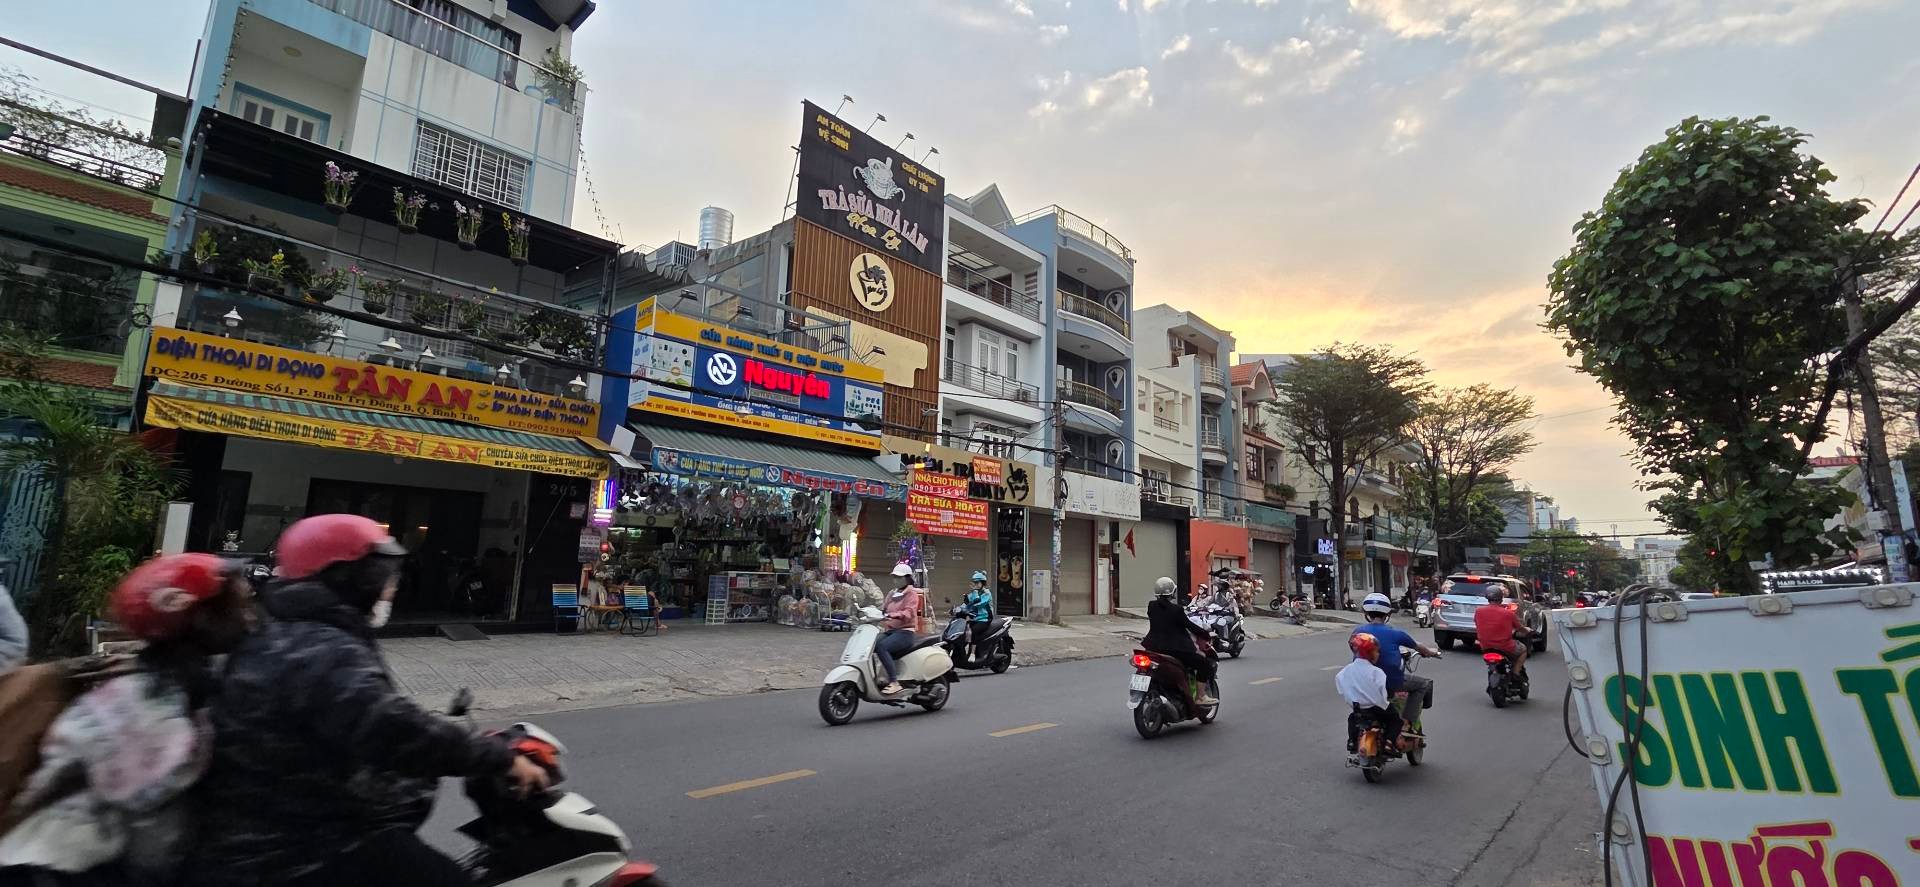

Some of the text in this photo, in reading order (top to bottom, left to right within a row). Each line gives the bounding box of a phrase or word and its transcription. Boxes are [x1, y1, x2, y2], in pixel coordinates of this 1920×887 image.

[816, 114, 851, 139] AN TOÀN
[818, 128, 849, 151] VỆ SINH
[908, 176, 928, 193] UY TÍN
[818, 184, 928, 254] TRÀ SỮA NHÀ LÀM
[846, 212, 902, 251] Hoa Ly
[156, 336, 198, 361] ĐIỆN
[202, 344, 254, 370] THOẠI
[256, 354, 274, 371] DI
[332, 365, 413, 402] TÂN
[418, 382, 473, 411] AN
[744, 358, 831, 400] Nguyên
[214, 375, 260, 390] Đường
[314, 390, 342, 402] Bình
[433, 408, 457, 418] Bình
[460, 412, 480, 422] Tân
[494, 390, 518, 402] MUA
[520, 394, 542, 406] BÁN
[507, 404, 532, 417] KÍNH
[534, 408, 557, 422] ĐIỆN
[560, 413, 589, 428] THOẠI
[197, 406, 218, 426] CỬA
[220, 411, 247, 430] HÀNG
[249, 416, 272, 435] ĐIỆN
[274, 420, 300, 439] THOẠI
[302, 425, 312, 438] DI
[313, 425, 337, 442] ĐỘNG
[340, 429, 420, 454] TÂN
[430, 442, 482, 462] AN
[486, 447, 514, 460] CHUYÊN
[515, 448, 528, 462] SỬA
[680, 456, 693, 470] CỬA
[782, 468, 885, 498] Nguyên
[915, 473, 968, 488] NHÀ CHO THUÊ
[910, 494, 931, 506] TRÀ
[955, 501, 974, 512] HOA
[975, 504, 985, 514] LY
[1604, 672, 1840, 795] SINH
